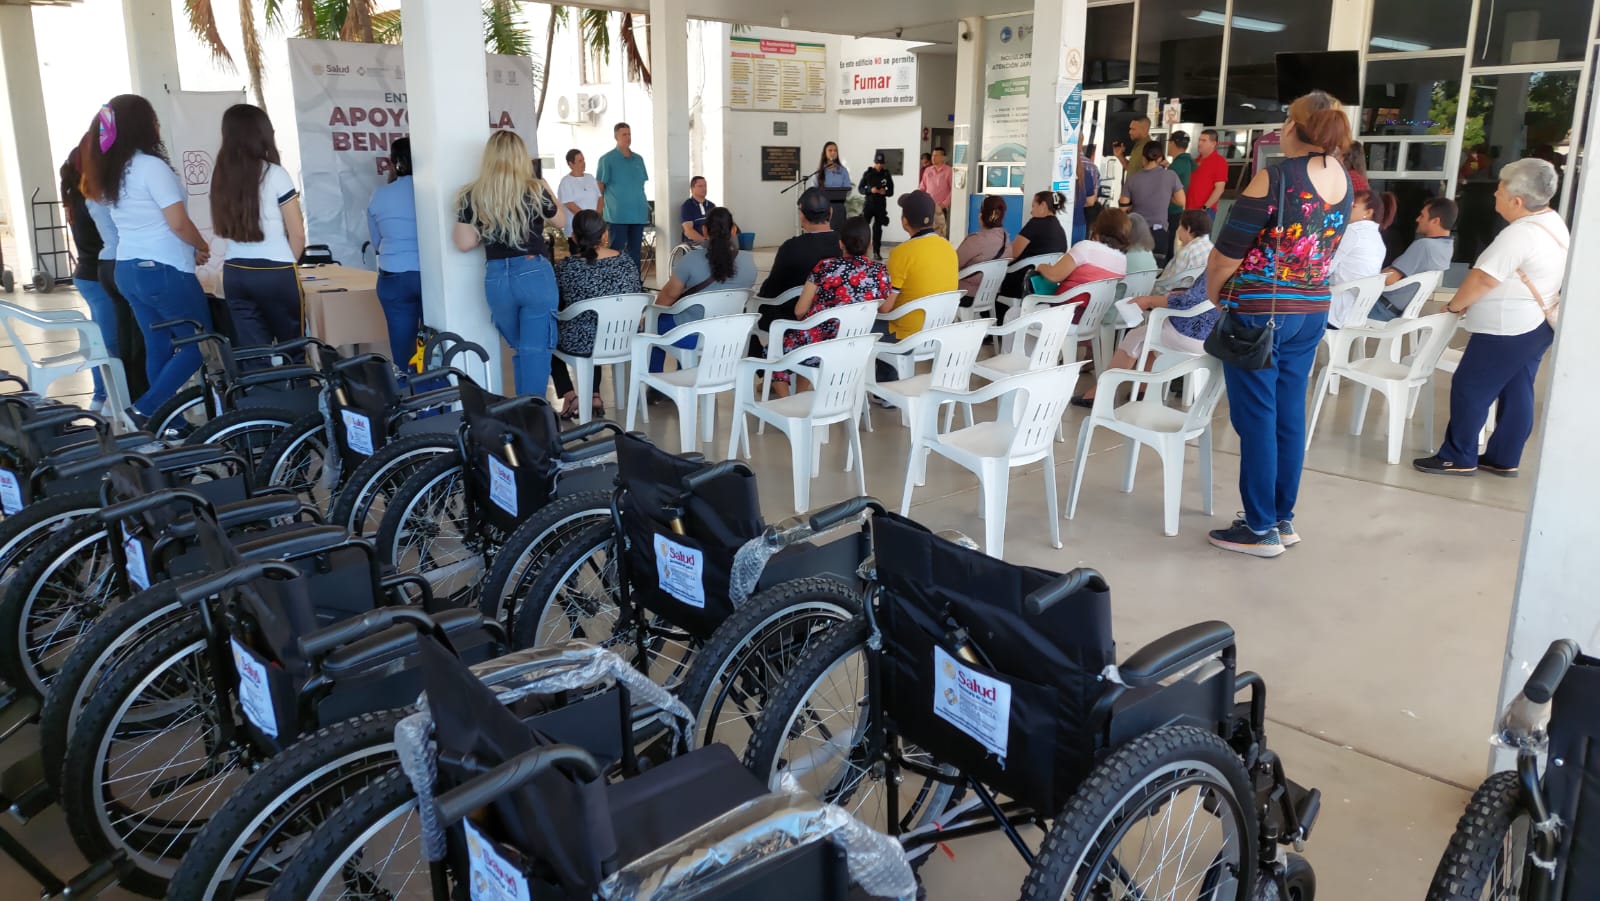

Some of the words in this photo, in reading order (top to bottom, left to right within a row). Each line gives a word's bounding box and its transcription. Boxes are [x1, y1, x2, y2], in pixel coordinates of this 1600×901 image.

[326, 65, 350, 73] Salud
[891, 56, 915, 66] permite
[853, 73, 892, 91] Fumar
[328, 107, 409, 127] APOY
[669, 547, 695, 566] Salud
[957, 670, 996, 702] Salud
